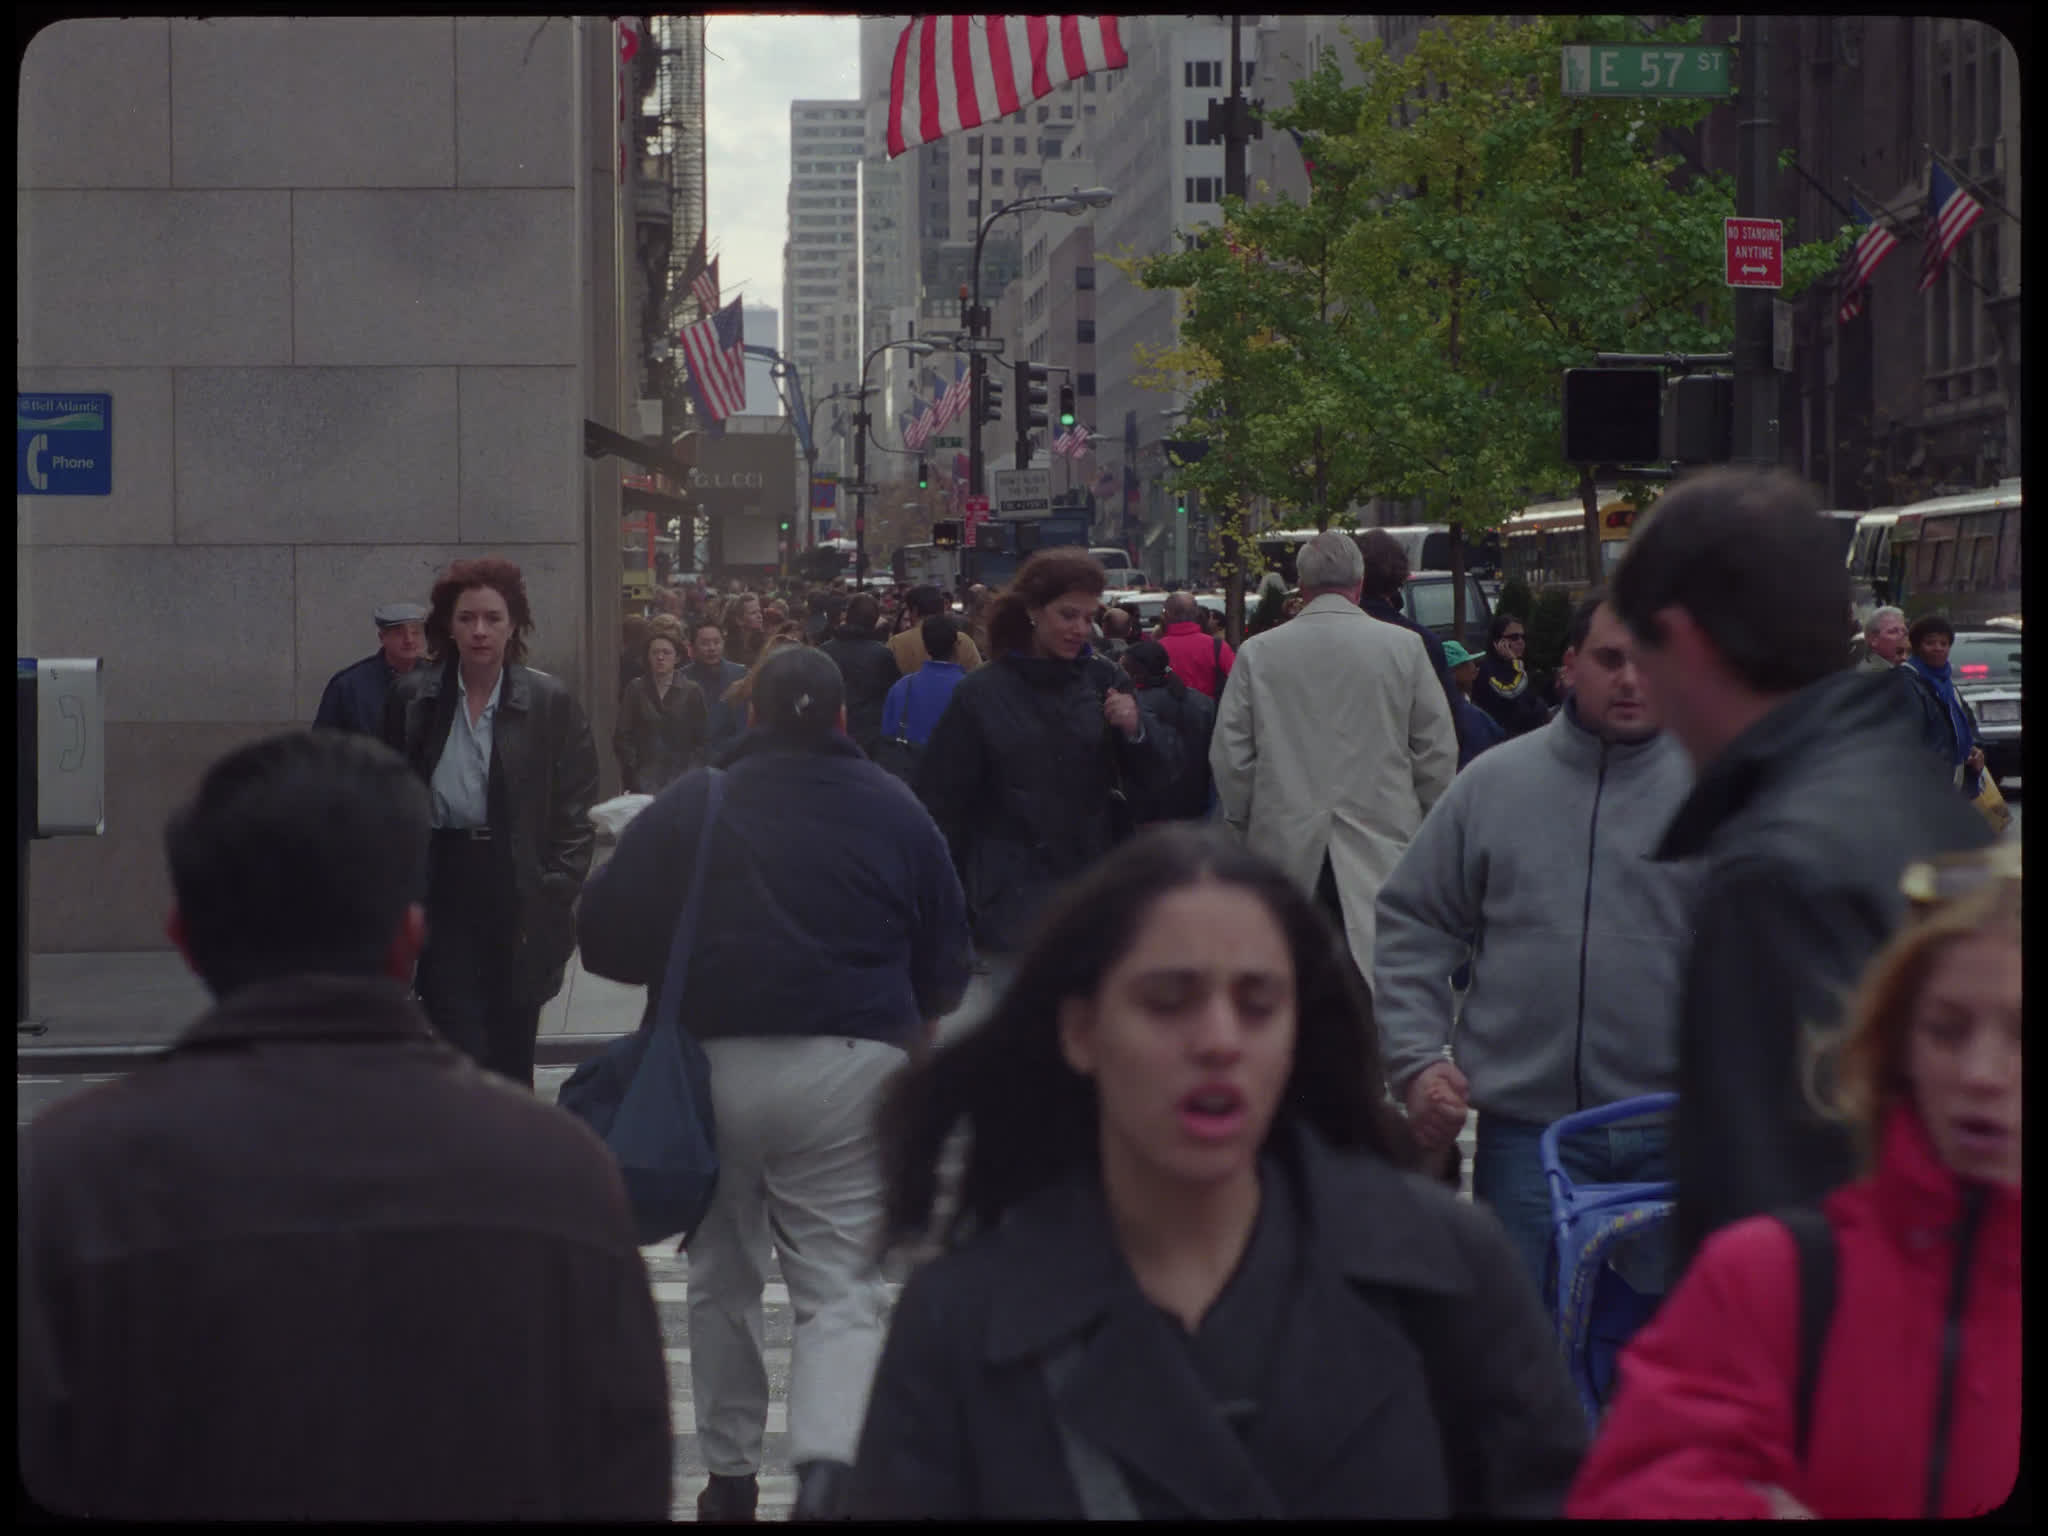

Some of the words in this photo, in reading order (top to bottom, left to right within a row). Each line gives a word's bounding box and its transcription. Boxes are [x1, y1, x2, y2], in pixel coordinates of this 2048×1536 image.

[1600, 51, 1619, 87] E
[1640, 52, 1685, 88] 57
[1697, 53, 1723, 71] ST
[1728, 226, 1739, 240] NO
[1743, 226, 1780, 242] STANDING
[1735, 246, 1774, 260] ANYTIME
[32, 400, 54, 411] Bell
[57, 400, 99, 411] Atlantic
[52, 455, 95, 469] Phone
